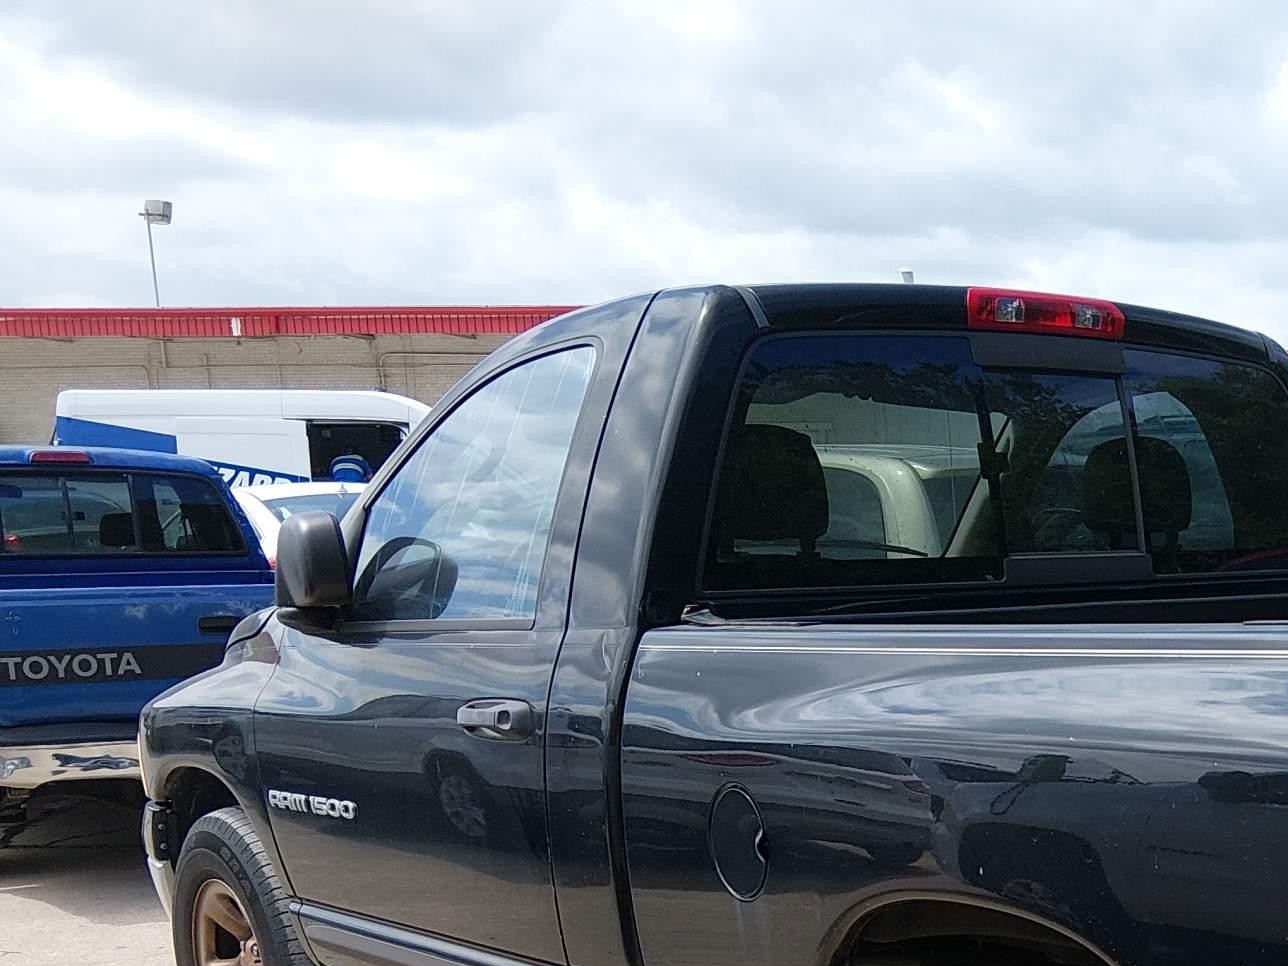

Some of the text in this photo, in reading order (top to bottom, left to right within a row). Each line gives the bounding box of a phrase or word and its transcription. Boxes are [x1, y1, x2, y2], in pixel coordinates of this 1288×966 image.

[0, 652, 142, 680] TOYOTA
[268, 789, 356, 819] RAM 1500
